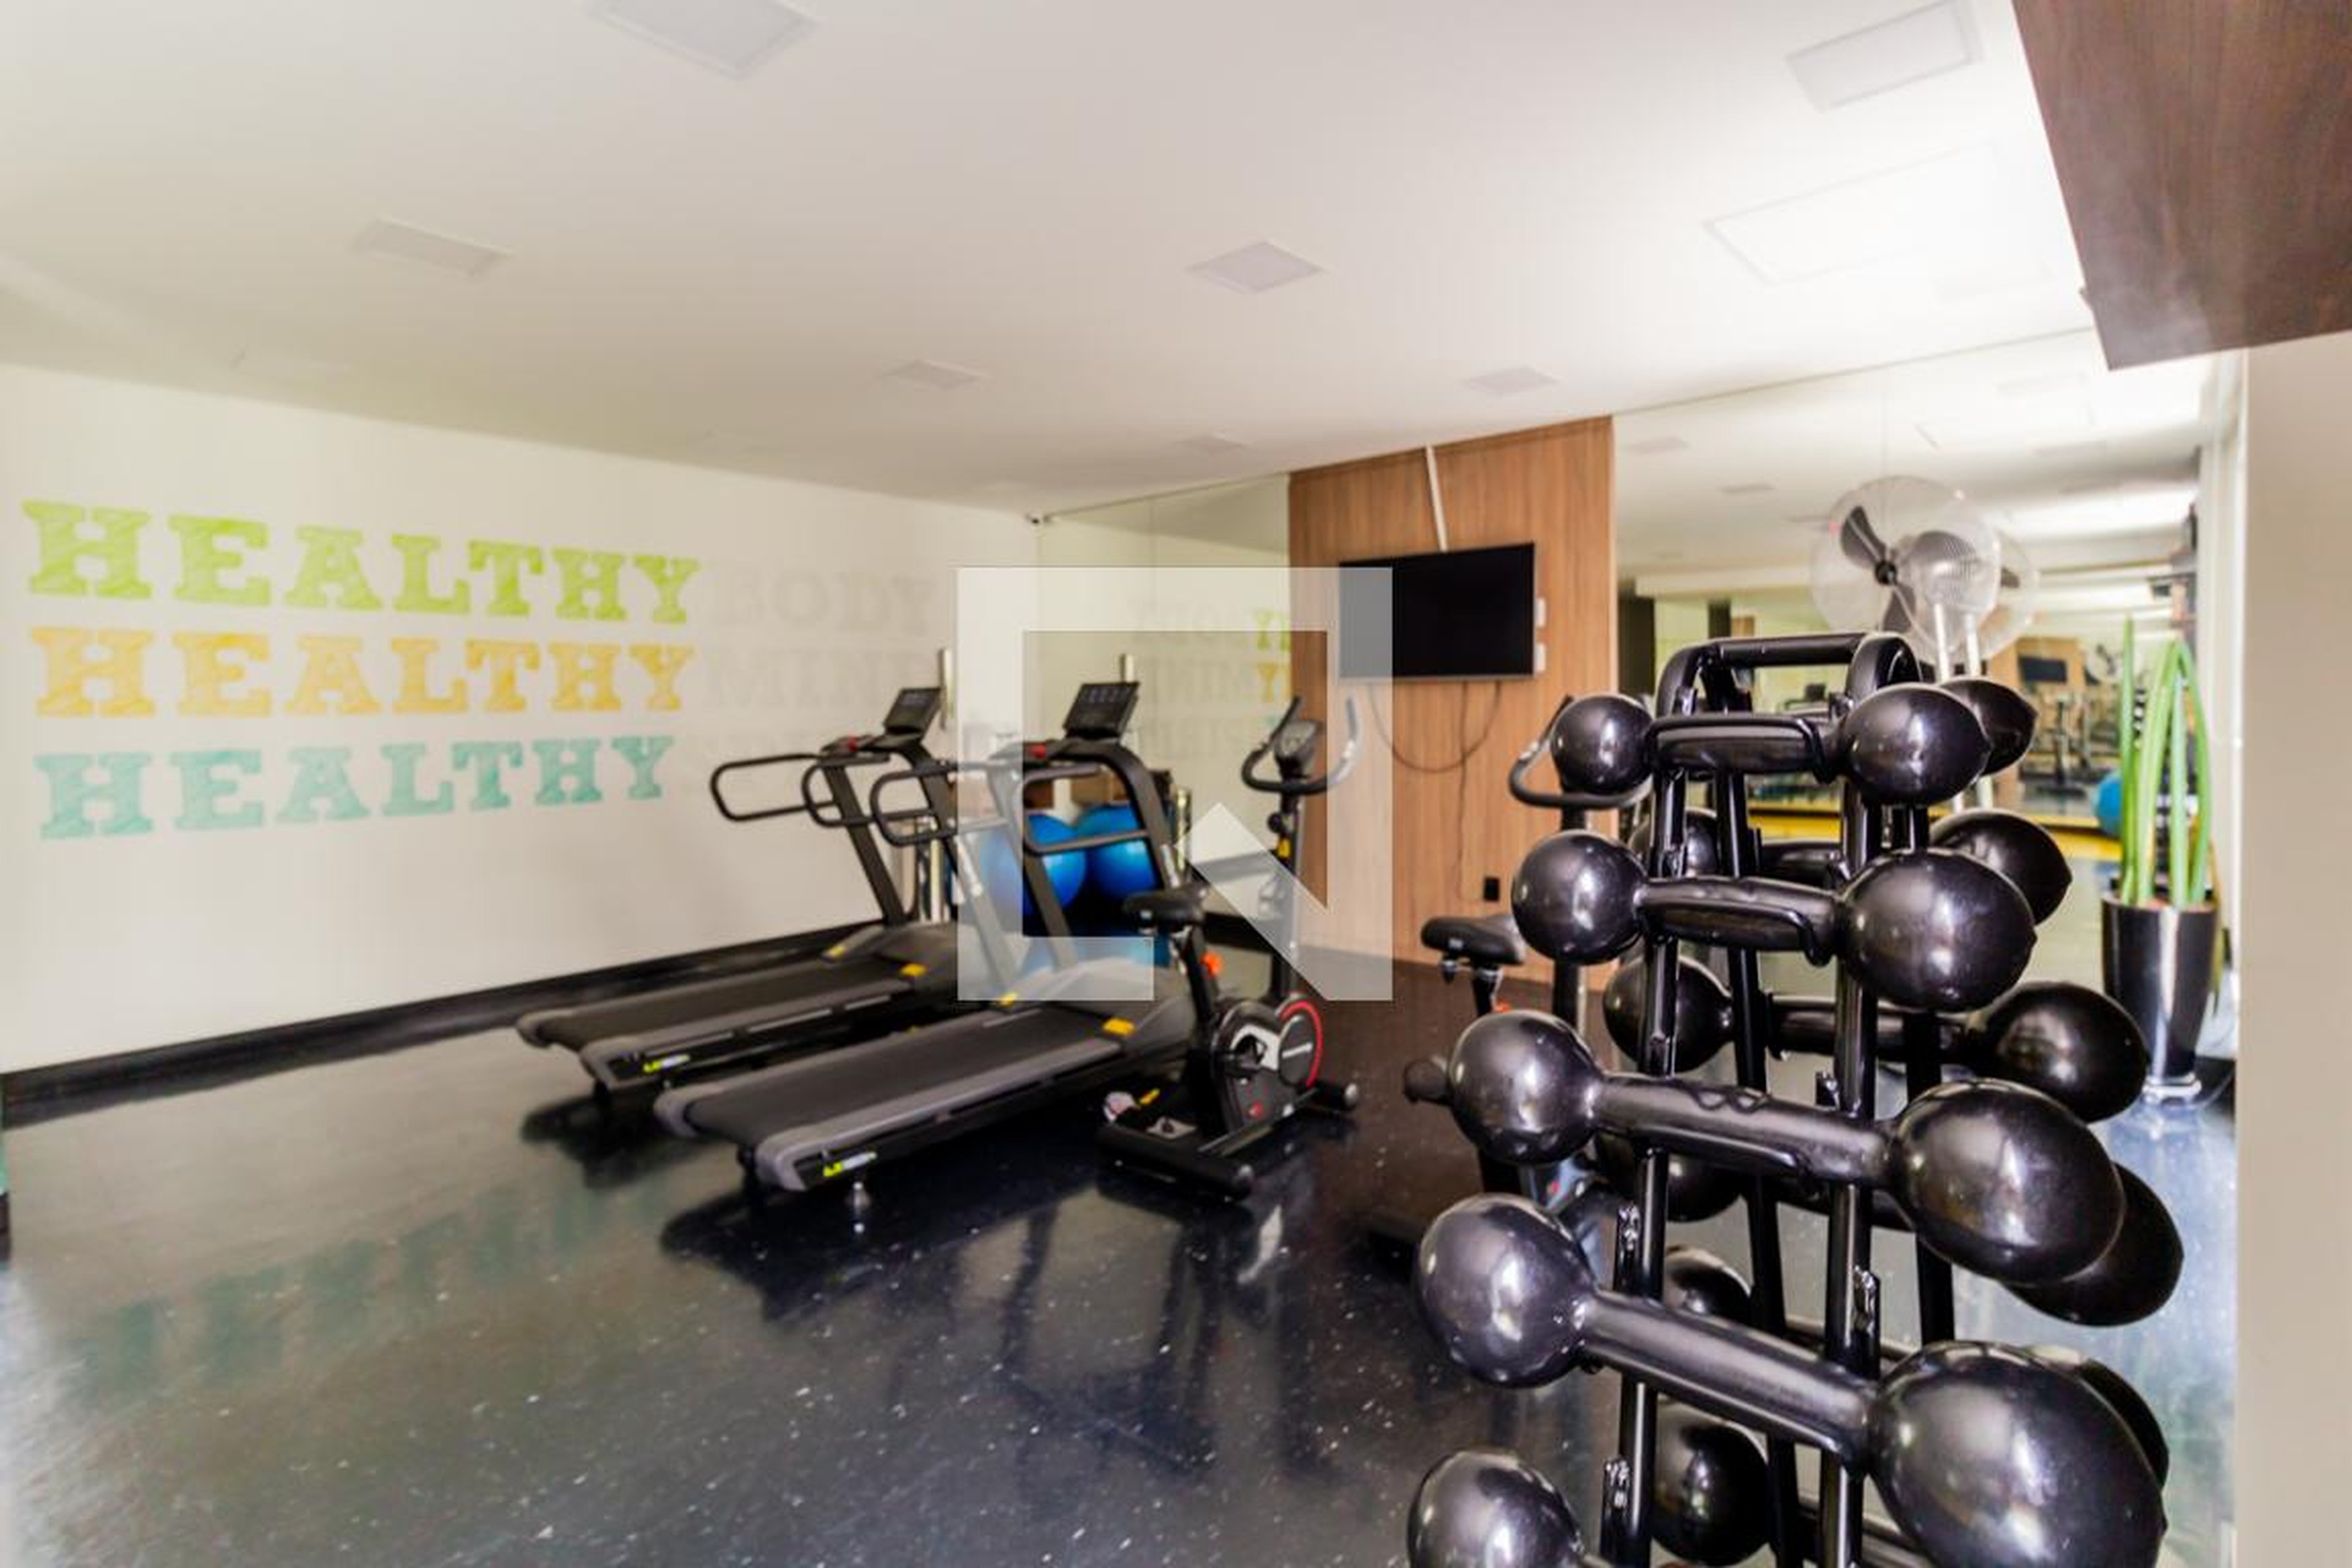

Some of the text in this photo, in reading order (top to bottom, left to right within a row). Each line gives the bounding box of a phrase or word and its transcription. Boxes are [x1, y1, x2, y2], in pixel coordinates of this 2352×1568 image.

[22, 499, 701, 624] HEALTHY
[31, 626, 695, 719] HEALTHY
[33, 736, 674, 840] HEALTHY
